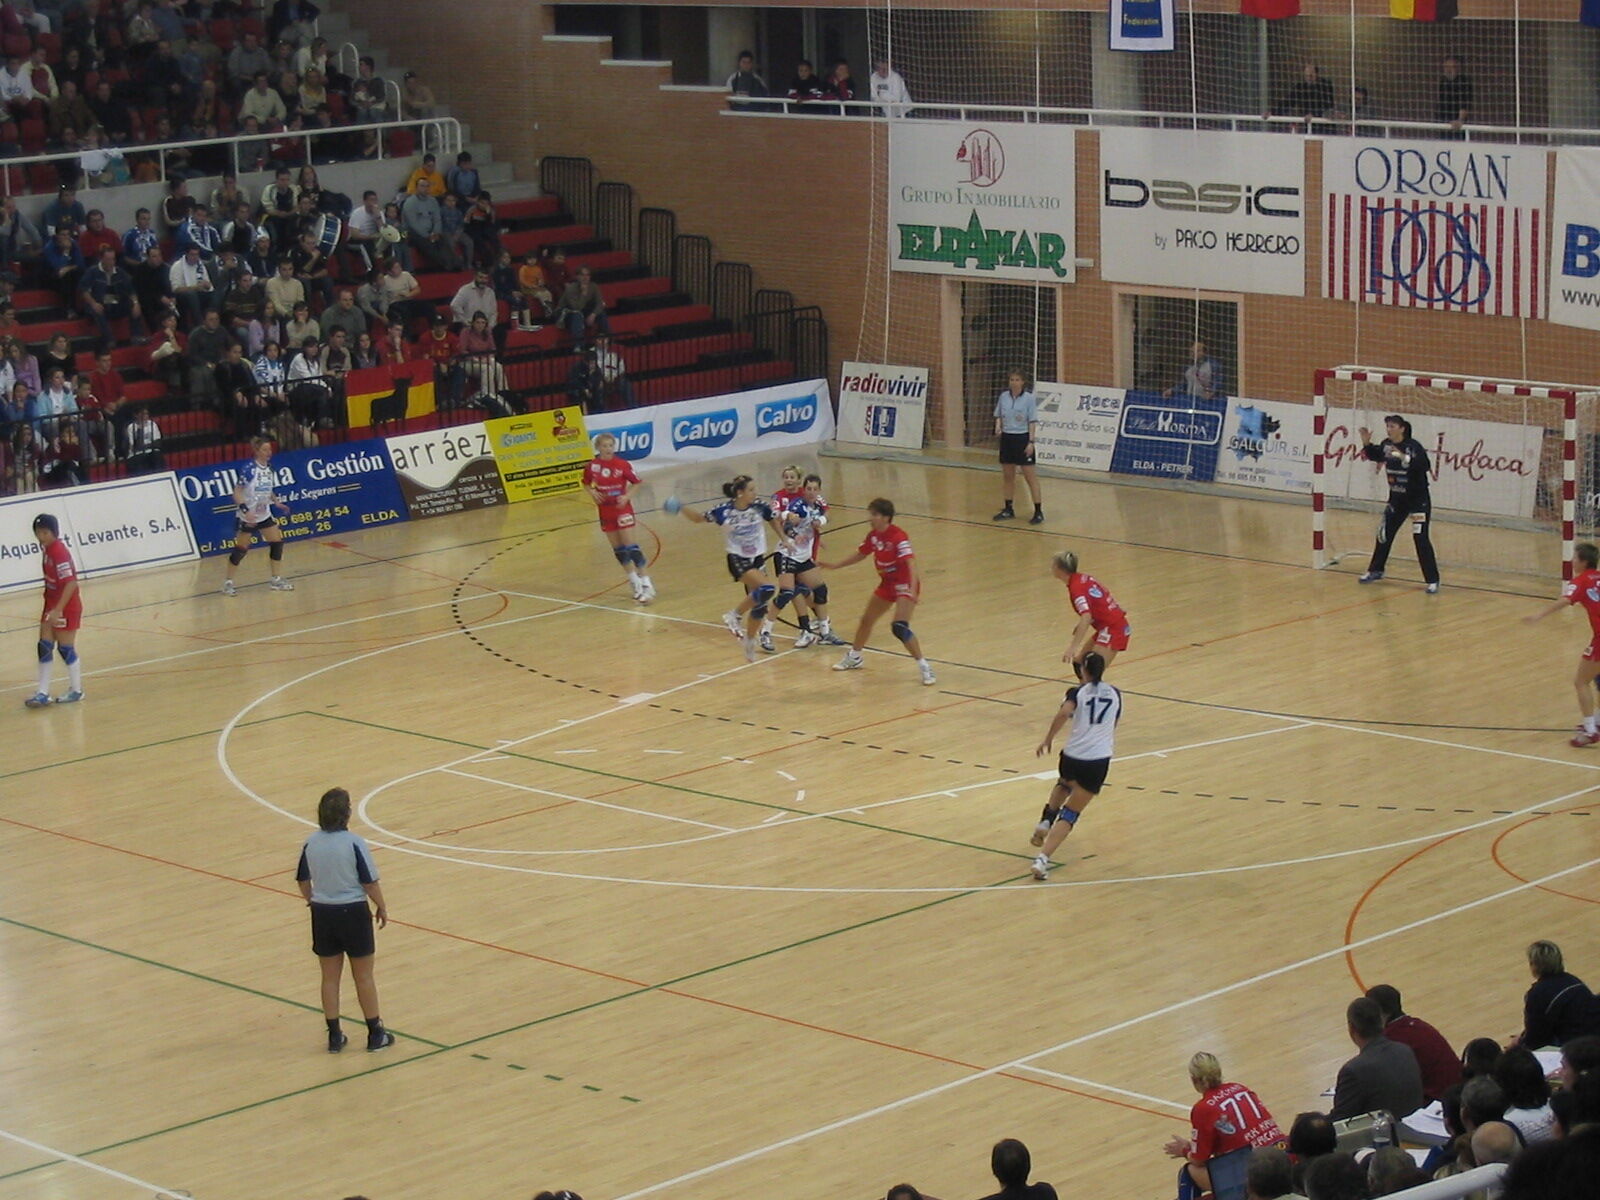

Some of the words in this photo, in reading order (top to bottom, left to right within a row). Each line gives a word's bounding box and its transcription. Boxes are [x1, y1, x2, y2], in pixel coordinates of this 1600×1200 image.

[1355, 147, 1511, 200] ORSAN
[901, 186, 952, 205] GRUPO
[1105, 170, 1300, 217] basic
[897, 208, 1067, 278] ELDAMAR
[1155, 233, 1167, 250] by
[1176, 229, 1217, 250] PACO
[1227, 232, 1300, 255] HERRERO
[842, 373, 926, 398] radiovivir
[757, 403, 814, 428] Calvo
[673, 417, 735, 443] Calvo
[392, 431, 493, 470] arráez
[307, 450, 385, 481] Gestión
[1133, 460, 1155, 471] ELDA
[1160, 463, 1194, 474] PETRER
[301, 485, 337, 500] Seguros
[315, 508, 332, 520] 24
[334, 504, 350, 516] 54
[362, 508, 399, 525] ELDA
[77, 523, 144, 546] Levante,
[148, 516, 181, 534] S.A.
[317, 521, 332, 534] 26
[1085, 696, 1113, 725] 17
[1219, 1090, 1262, 1130] 77
